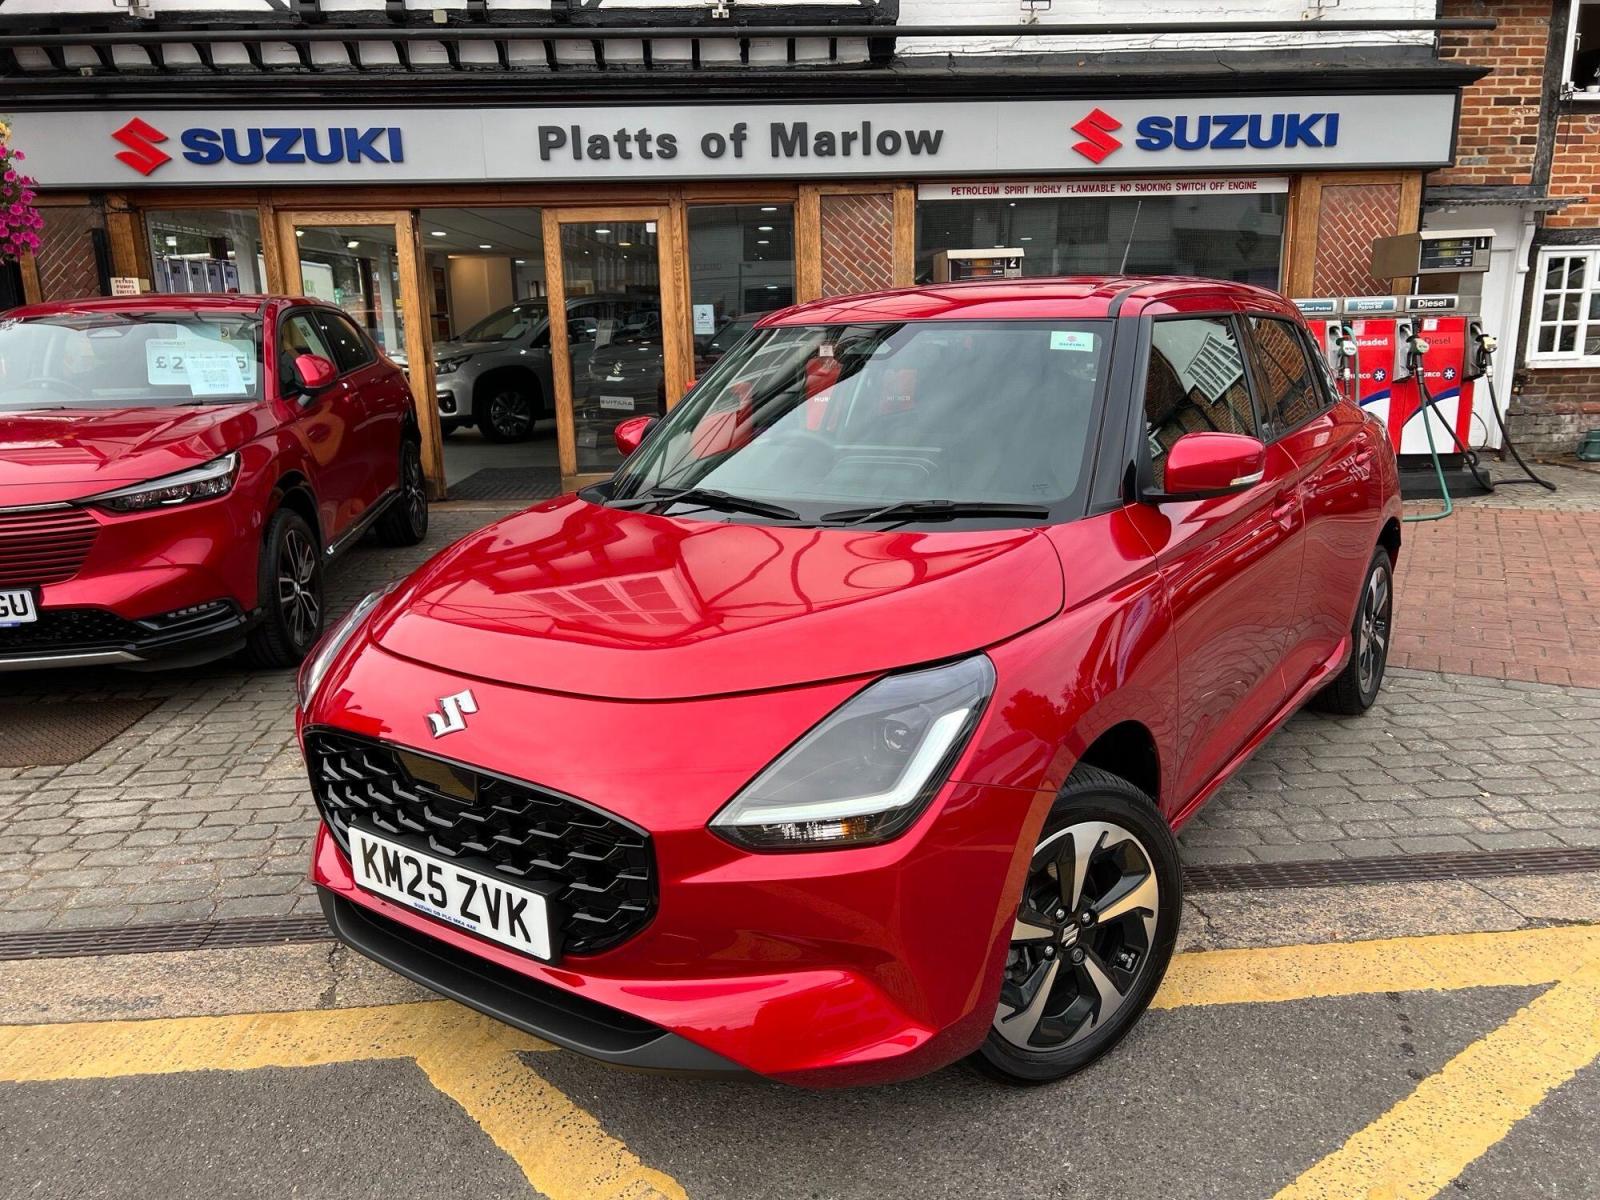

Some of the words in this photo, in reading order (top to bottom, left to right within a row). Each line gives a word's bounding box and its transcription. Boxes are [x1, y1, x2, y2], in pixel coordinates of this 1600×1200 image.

[1135, 112, 1340, 152] SUZUKI
[180, 127, 405, 165] SUZUKI
[537, 124, 679, 162] Platts
[701, 122, 748, 158] of
[769, 120, 944, 158] Marlow
[951, 186, 999, 196] PETROLEUM
[1004, 185, 1029, 195] SPIRIT
[1033, 184, 1062, 194] HIGHLY
[1066, 183, 1116, 193] FLAMMABLE
[1120, 182, 1131, 192] NO
[1135, 182, 1172, 192] SMOKING
[1176, 182, 1206, 191] SWITCH
[1210, 181, 1224, 191] OFF
[1228, 180, 1257, 190] ENGINE
[1480, 238, 1485, 248] 1
[1010, 257, 1016, 268] 2
[1418, 299, 1447, 308] Diesel
[1424, 336, 1451, 345] Diesel
[361, 838, 448, 908] KM25
[456, 874, 532, 943] ZVK
